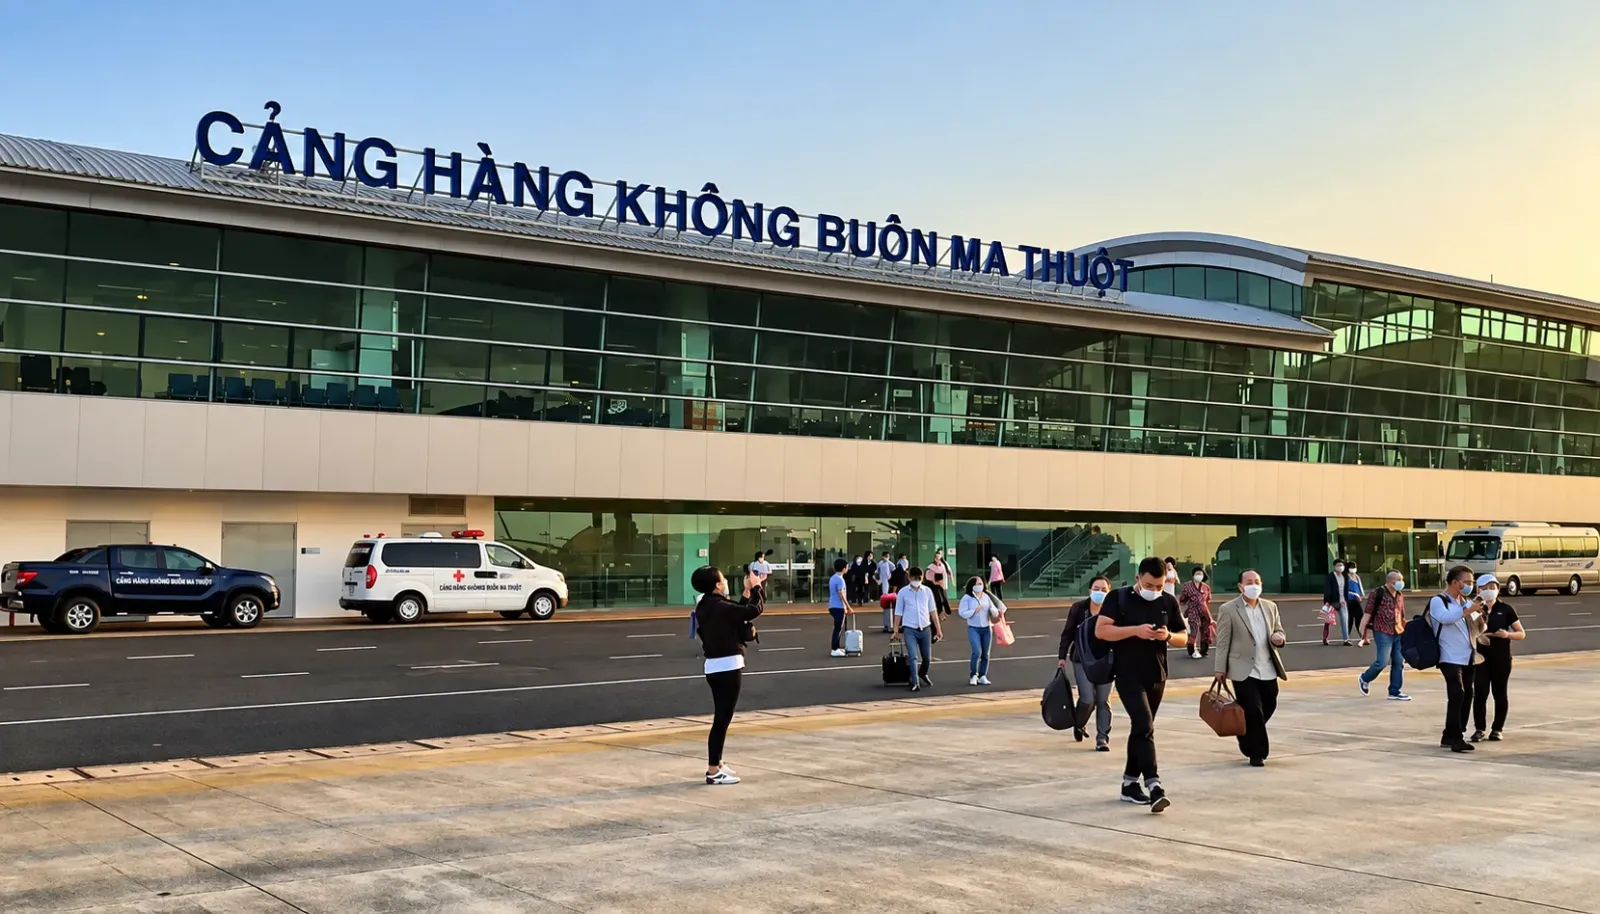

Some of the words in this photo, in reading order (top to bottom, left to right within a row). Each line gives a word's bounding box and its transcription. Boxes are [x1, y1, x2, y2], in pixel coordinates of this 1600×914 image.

[196, 101, 397, 189] CẢNG
[423, 142, 594, 217] HÀNG
[616, 180, 800, 248] KHÔNG
[817, 213, 937, 266] BUÔN
[951, 235, 1009, 277] MA
[1018, 245, 1134, 298] THUỘT
